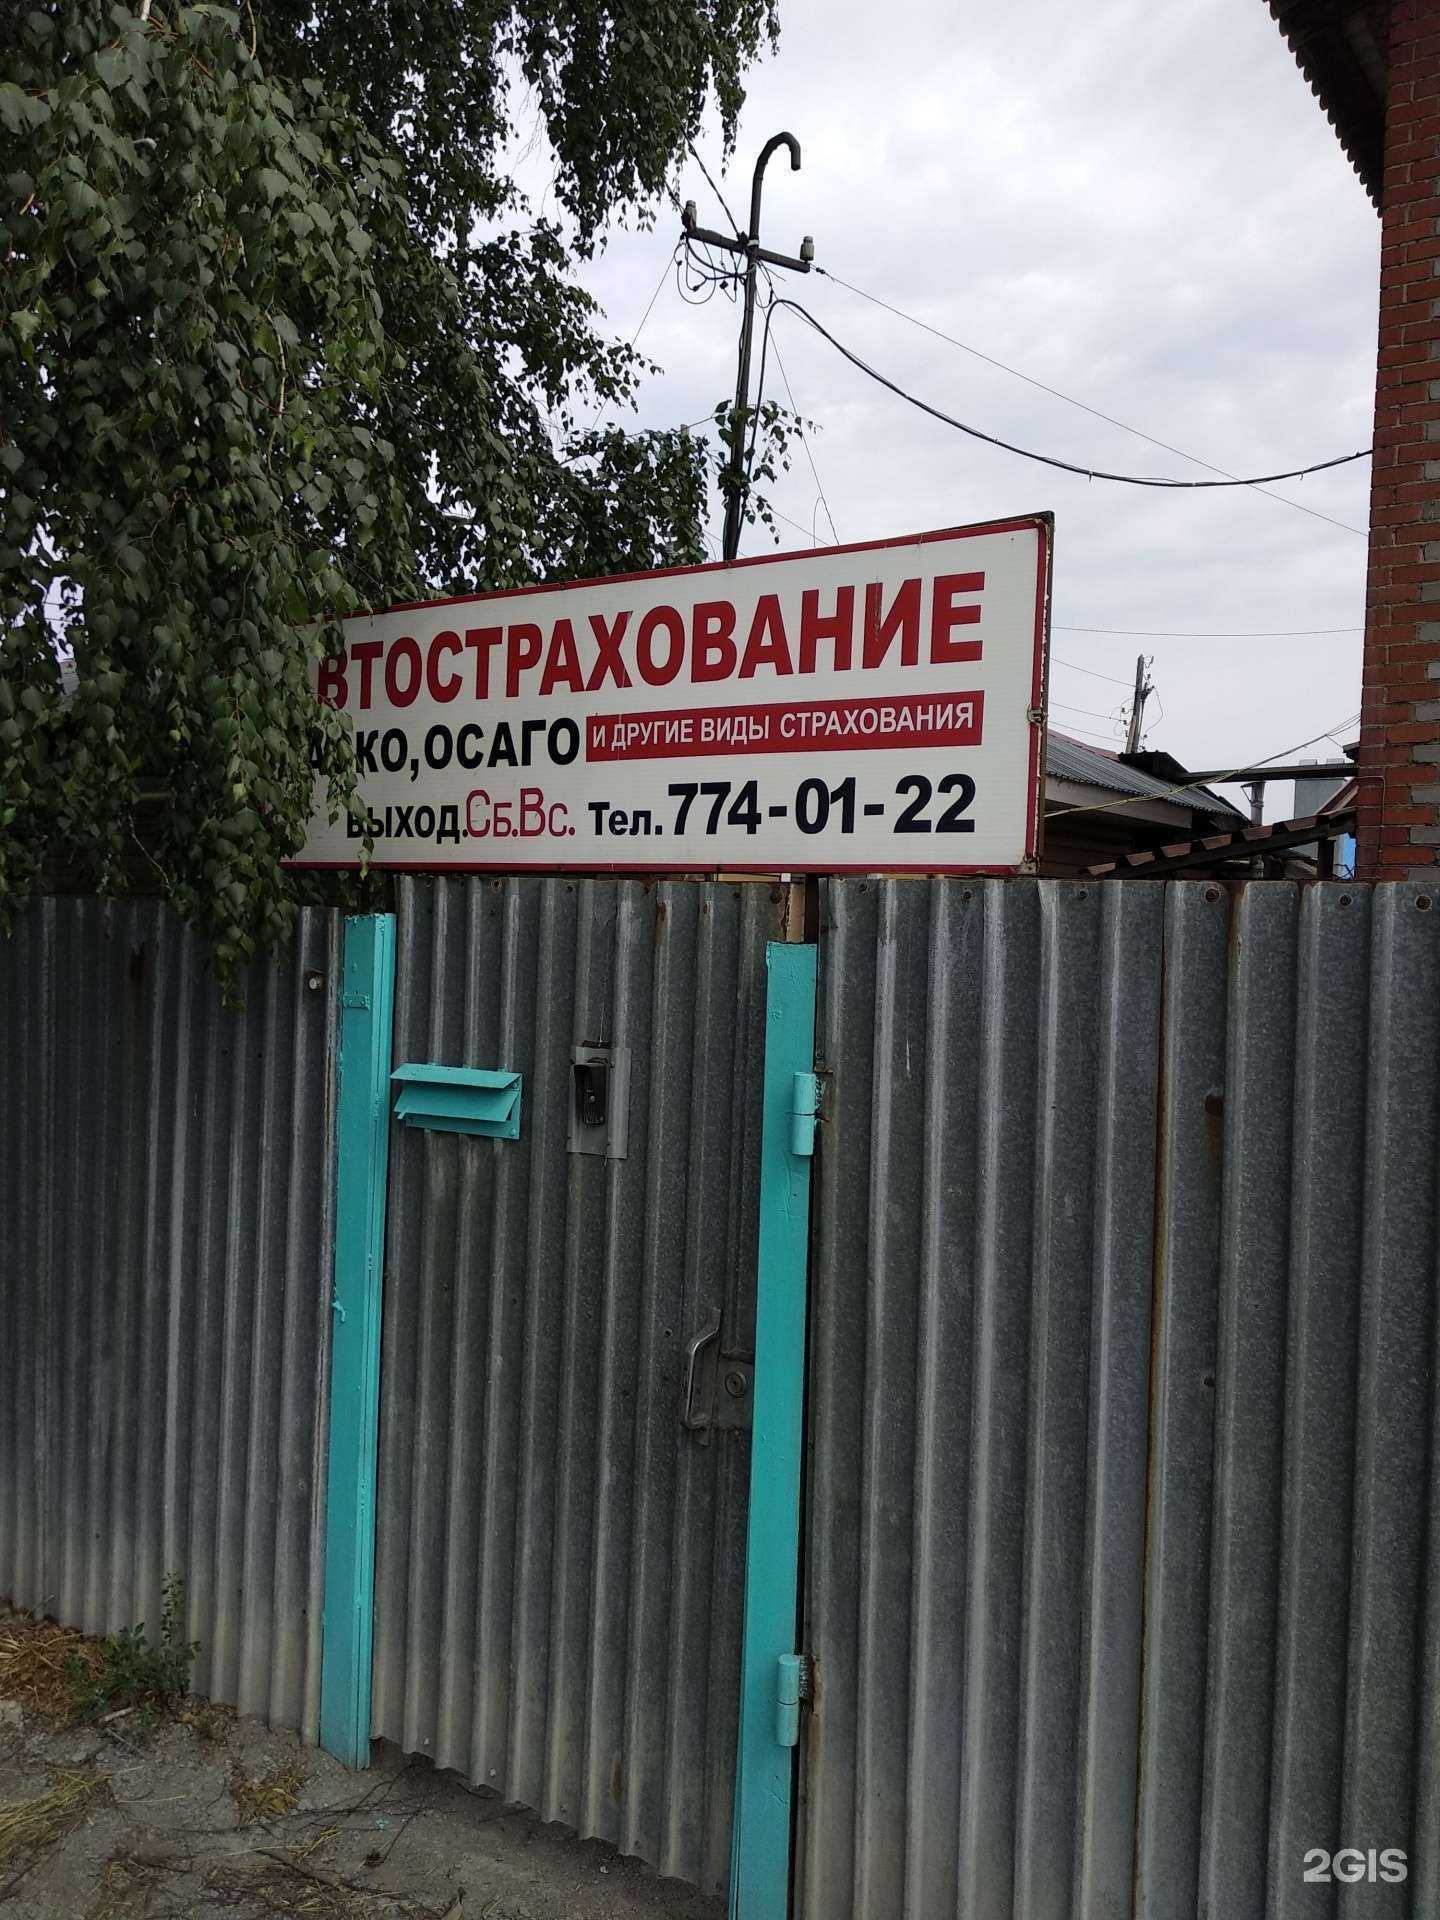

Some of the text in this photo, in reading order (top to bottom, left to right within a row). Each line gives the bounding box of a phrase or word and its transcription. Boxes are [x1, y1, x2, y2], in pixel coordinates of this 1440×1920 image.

[317, 571, 986, 711] ВТОСТРАХОВАНИЕ
[592, 701, 974, 752] И ДРУГИЕ ВИДЫ СТРАХОВАНИЯ
[667, 773, 976, 836] 774-01-22
